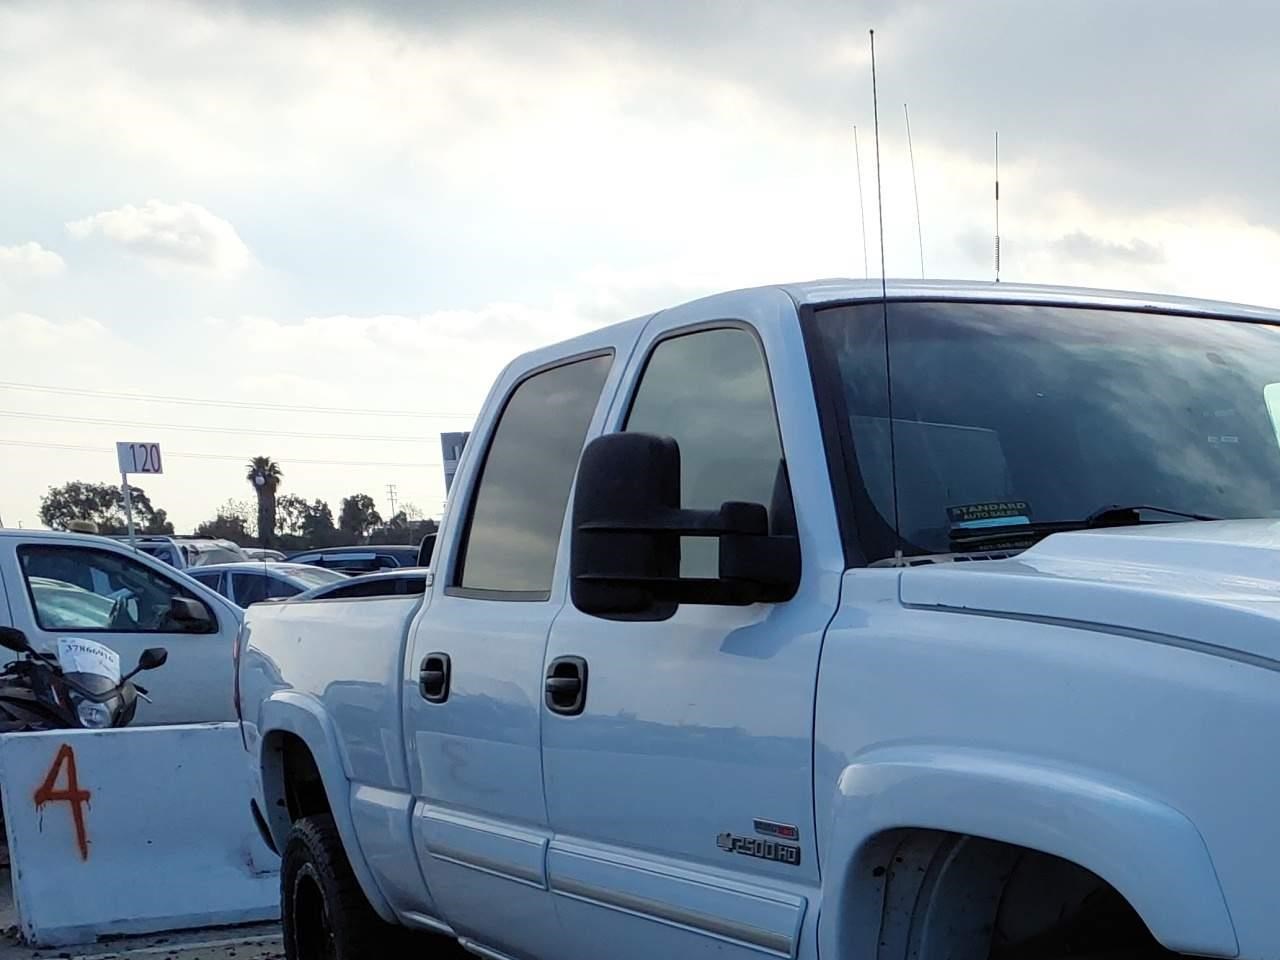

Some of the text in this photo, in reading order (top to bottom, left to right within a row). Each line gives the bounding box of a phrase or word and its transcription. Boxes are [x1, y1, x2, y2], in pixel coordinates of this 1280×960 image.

[129, 444, 161, 472] 120
[953, 503, 1027, 515] STANDARD
[963, 511, 987, 520] AUTO
[35, 744, 91, 862] 4
[735, 838, 797, 862] 2500 HD
